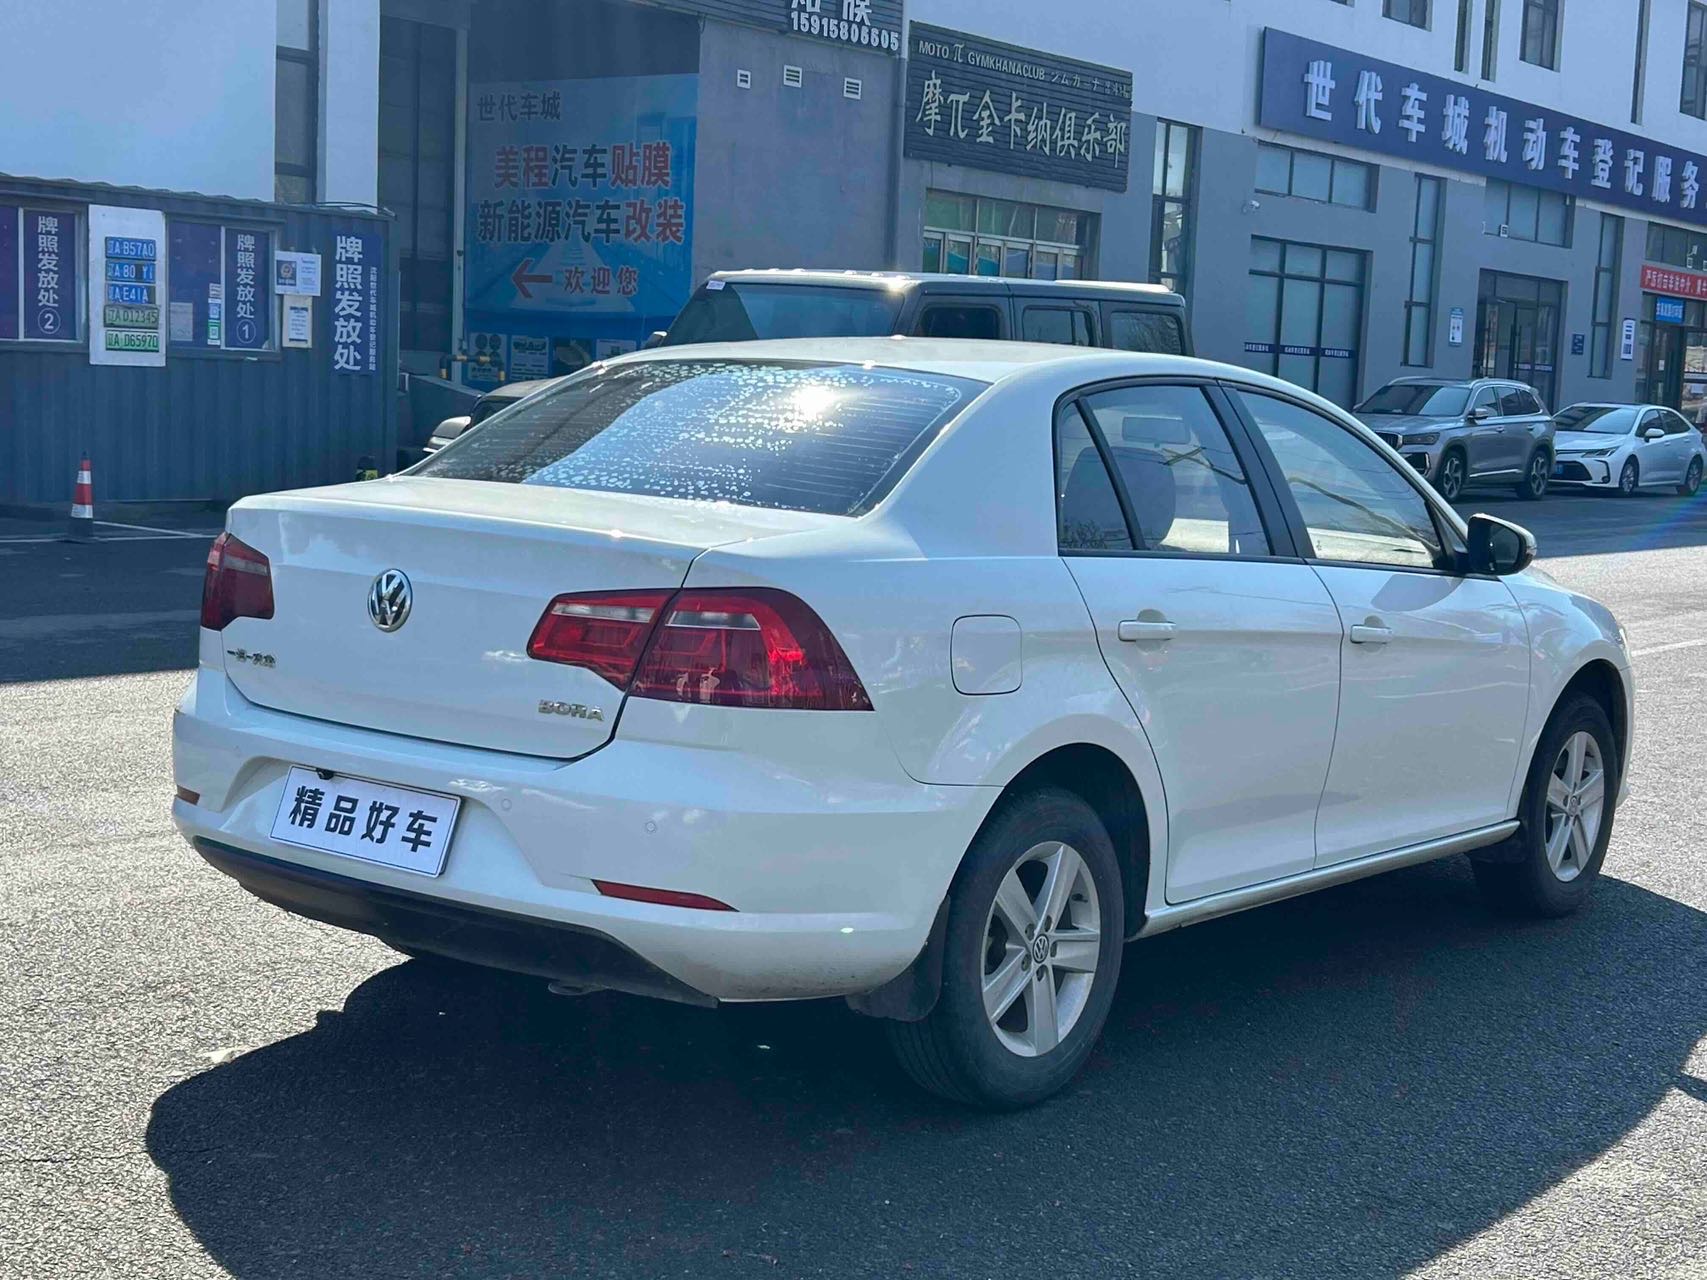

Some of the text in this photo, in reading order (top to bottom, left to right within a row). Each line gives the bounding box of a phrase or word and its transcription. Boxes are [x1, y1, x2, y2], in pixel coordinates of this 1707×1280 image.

[791, 11, 899, 51] 15915806605
[919, 40, 950, 58] MOTO
[968, 51, 1046, 81] GYMKHANACLUB
[477, 91, 562, 122] 世代车城
[1304, 59, 1707, 209] 世代车城机动车登记服务
[494, 143, 672, 189] 美程汽车贴膜
[478, 199, 686, 245] 新能源汽车改装
[37, 215, 59, 308] 牌照发放处
[236, 234, 256, 319] 牌照发放处
[564, 266, 639, 297] 欢迎您
[334, 235, 363, 371] 牌照发放处
[538, 699, 604, 721] BORA
[288, 785, 438, 853] 精品好车
